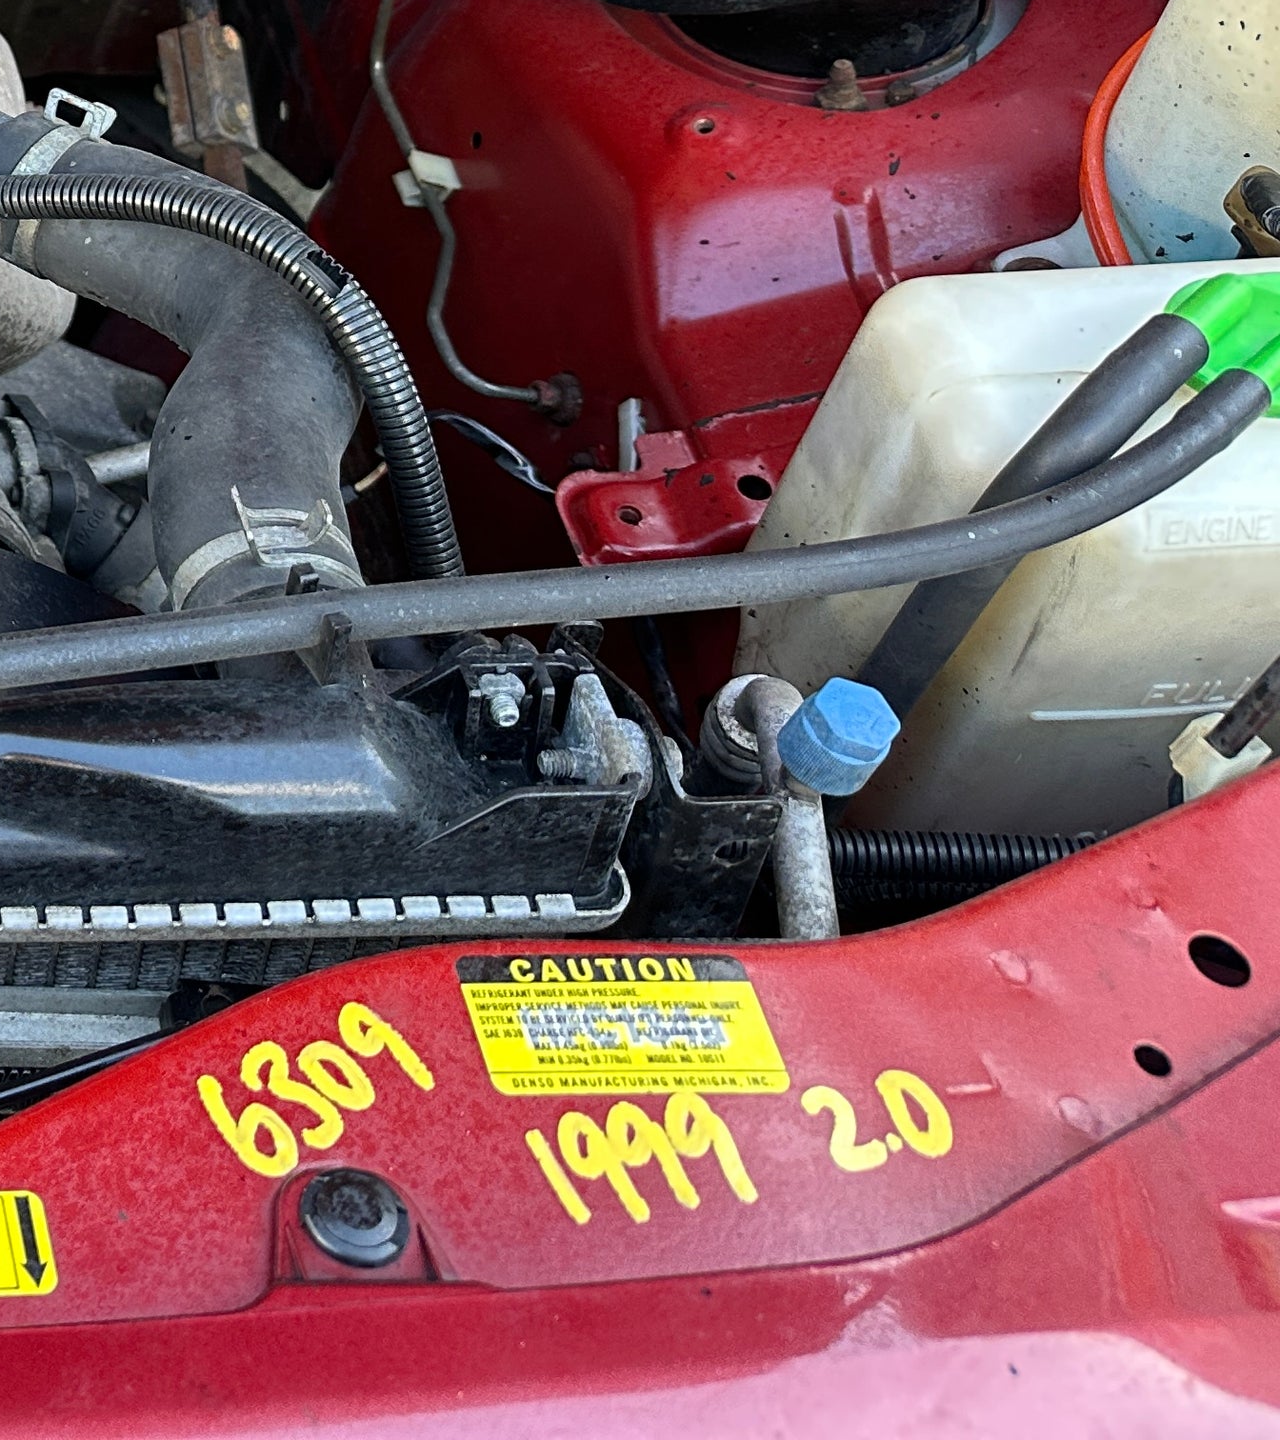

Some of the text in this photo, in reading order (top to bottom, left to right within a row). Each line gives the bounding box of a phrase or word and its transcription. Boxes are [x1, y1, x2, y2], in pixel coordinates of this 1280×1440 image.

[1164, 515, 1273, 546] ENGINE
[1141, 677, 1252, 705] FULL
[509, 957, 697, 983] CAUTION
[471, 987, 640, 998] REFRIGERANT UNDER HIGH PRESSURE.
[475, 1002, 522, 1011] IMPROPER
[525, 1001, 561, 1011] SERVICE
[565, 1001, 607, 1010] METHODS
[610, 1001, 627, 1009] MAY
[630, 1000, 658, 1010] CAUSE
[661, 1000, 707, 1010] PERSONAL
[479, 1015, 514, 1025] SYSTEM
[517, 1015, 528, 1024] TO
[530, 1015, 542, 1024] BE
[592, 1014, 603, 1023] BY
[483, 1029, 501, 1039] SAE
[646, 1054, 678, 1064] MODEL
[512, 1075, 775, 1089] DENSO MANUFACTURING MICHIGAN, INC.
[197, 1000, 436, 1179] 6309
[525, 1069, 954, 1226] 1999 2.0
